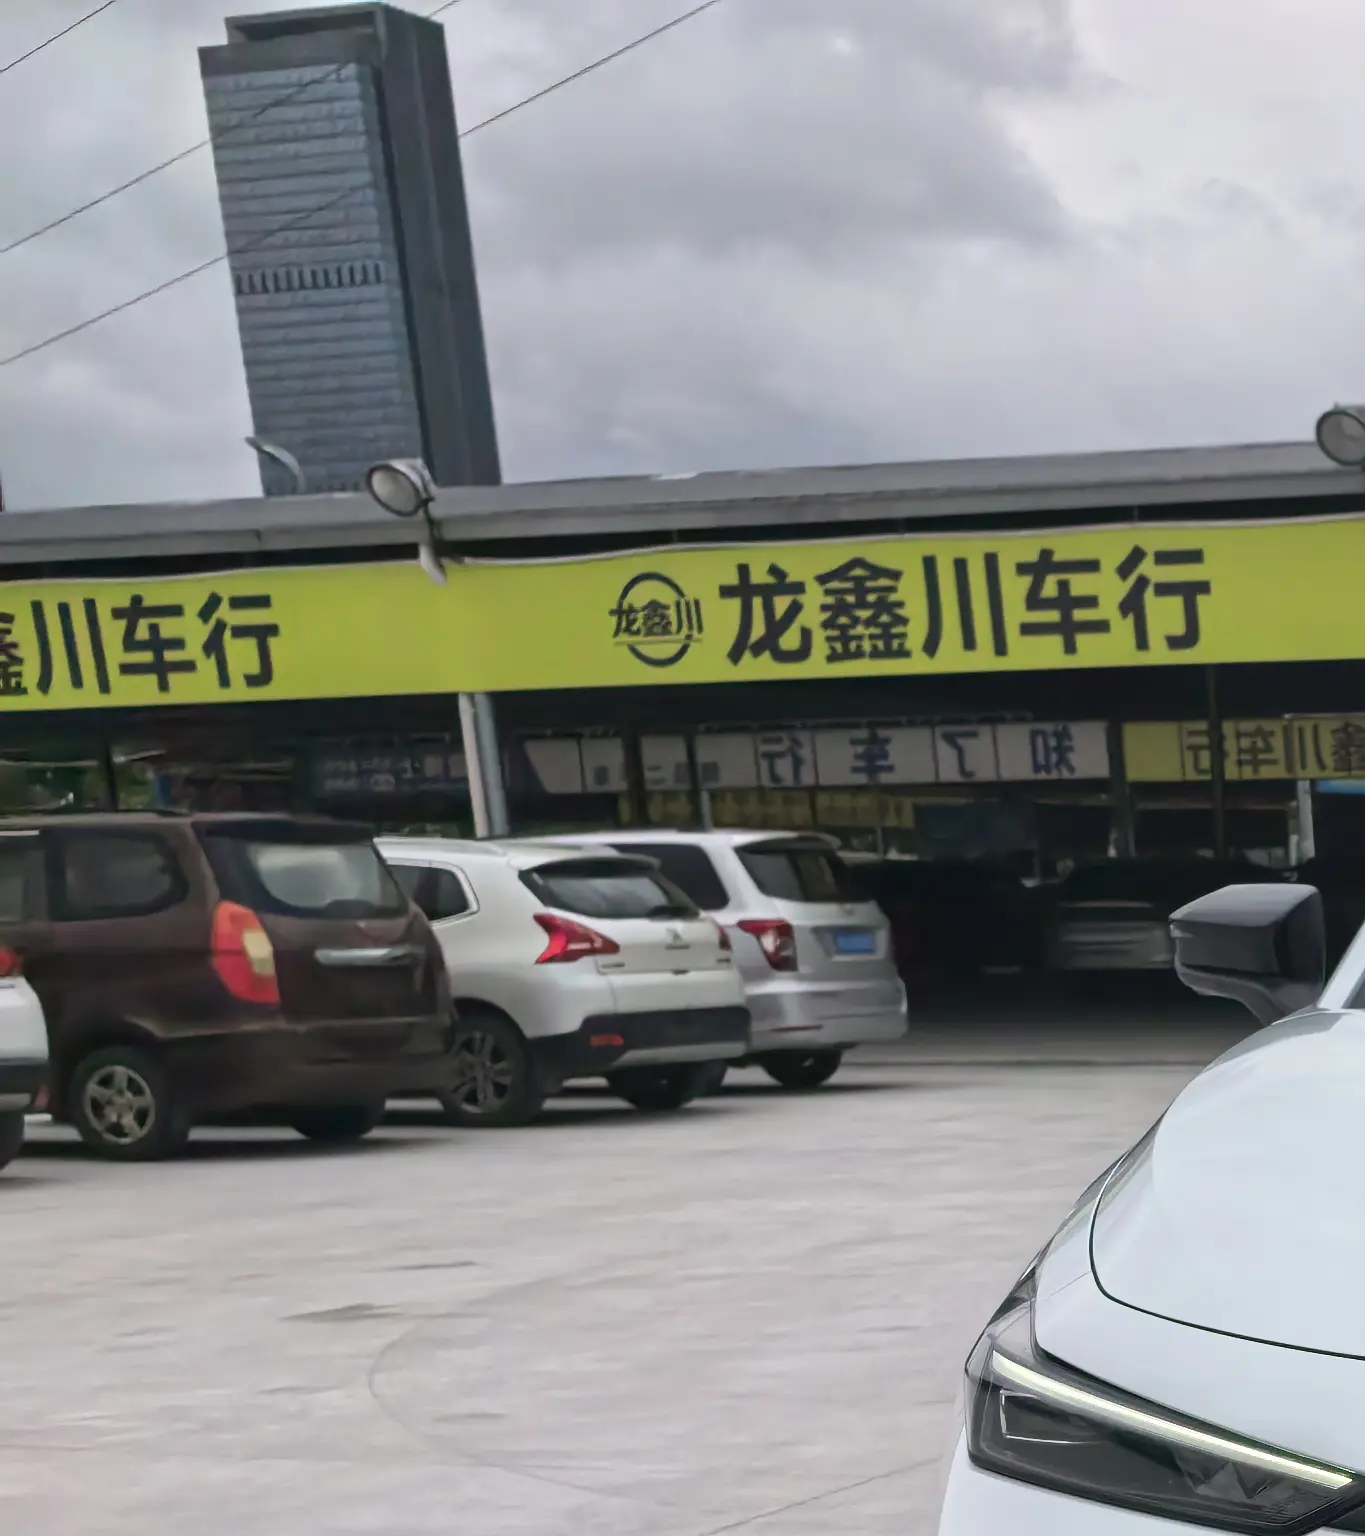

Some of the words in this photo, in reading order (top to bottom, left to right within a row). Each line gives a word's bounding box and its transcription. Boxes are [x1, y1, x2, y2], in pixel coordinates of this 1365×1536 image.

[718, 544, 1212, 667] 龙鑫川车行
